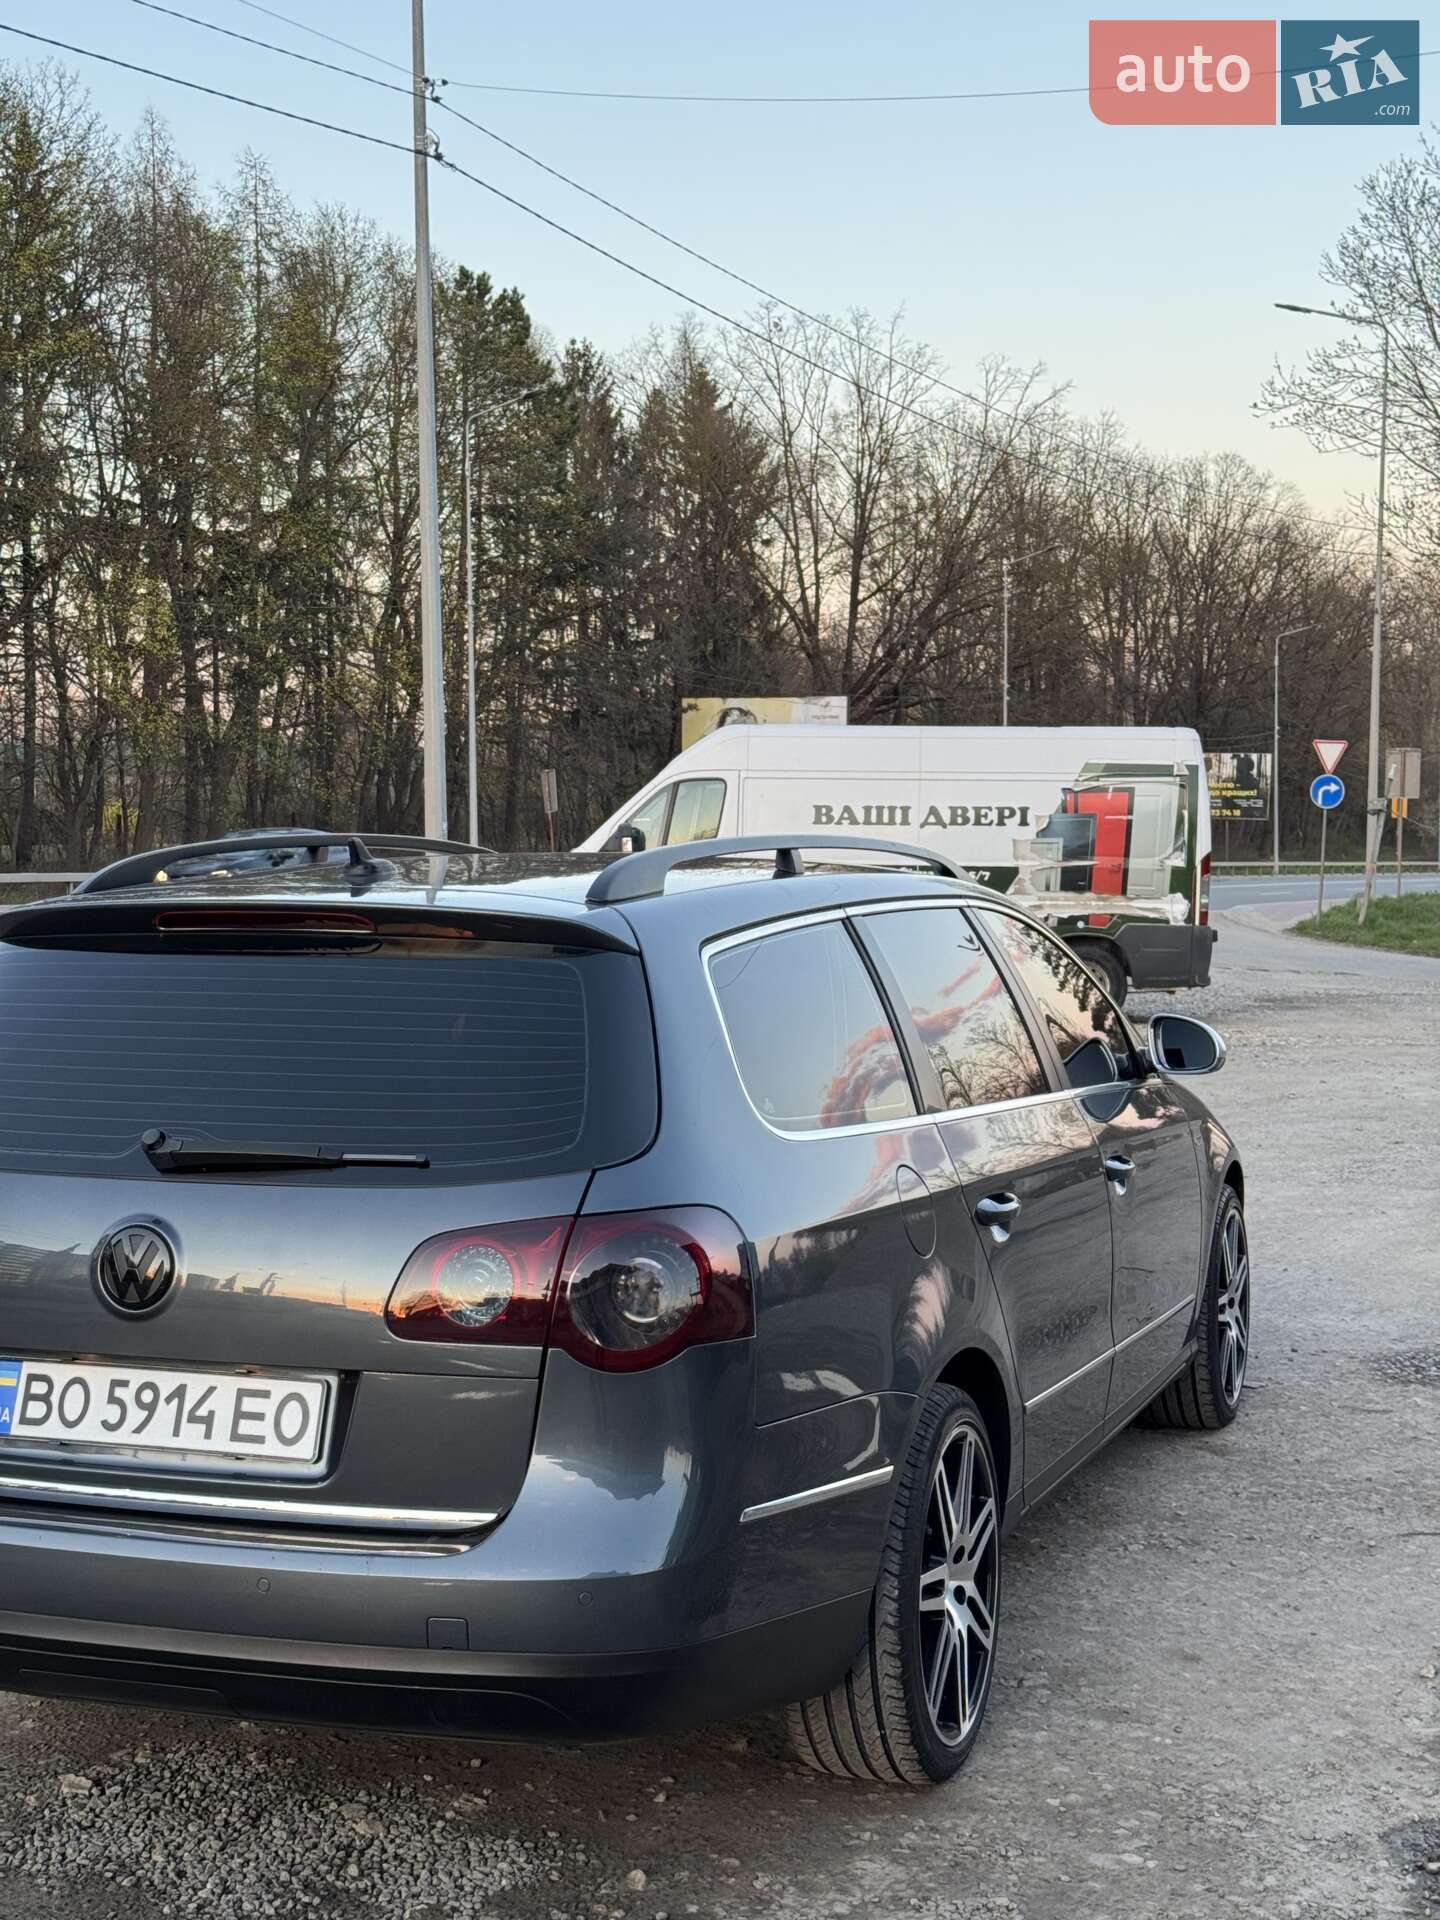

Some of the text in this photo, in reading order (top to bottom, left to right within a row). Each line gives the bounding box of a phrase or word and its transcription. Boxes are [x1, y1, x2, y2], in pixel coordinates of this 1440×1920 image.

[812, 804, 1030, 829] ВАШІ ДВЕРІ
[0, 1407, 10, 1424] A
[18, 1373, 310, 1447] BO 5914 EO
